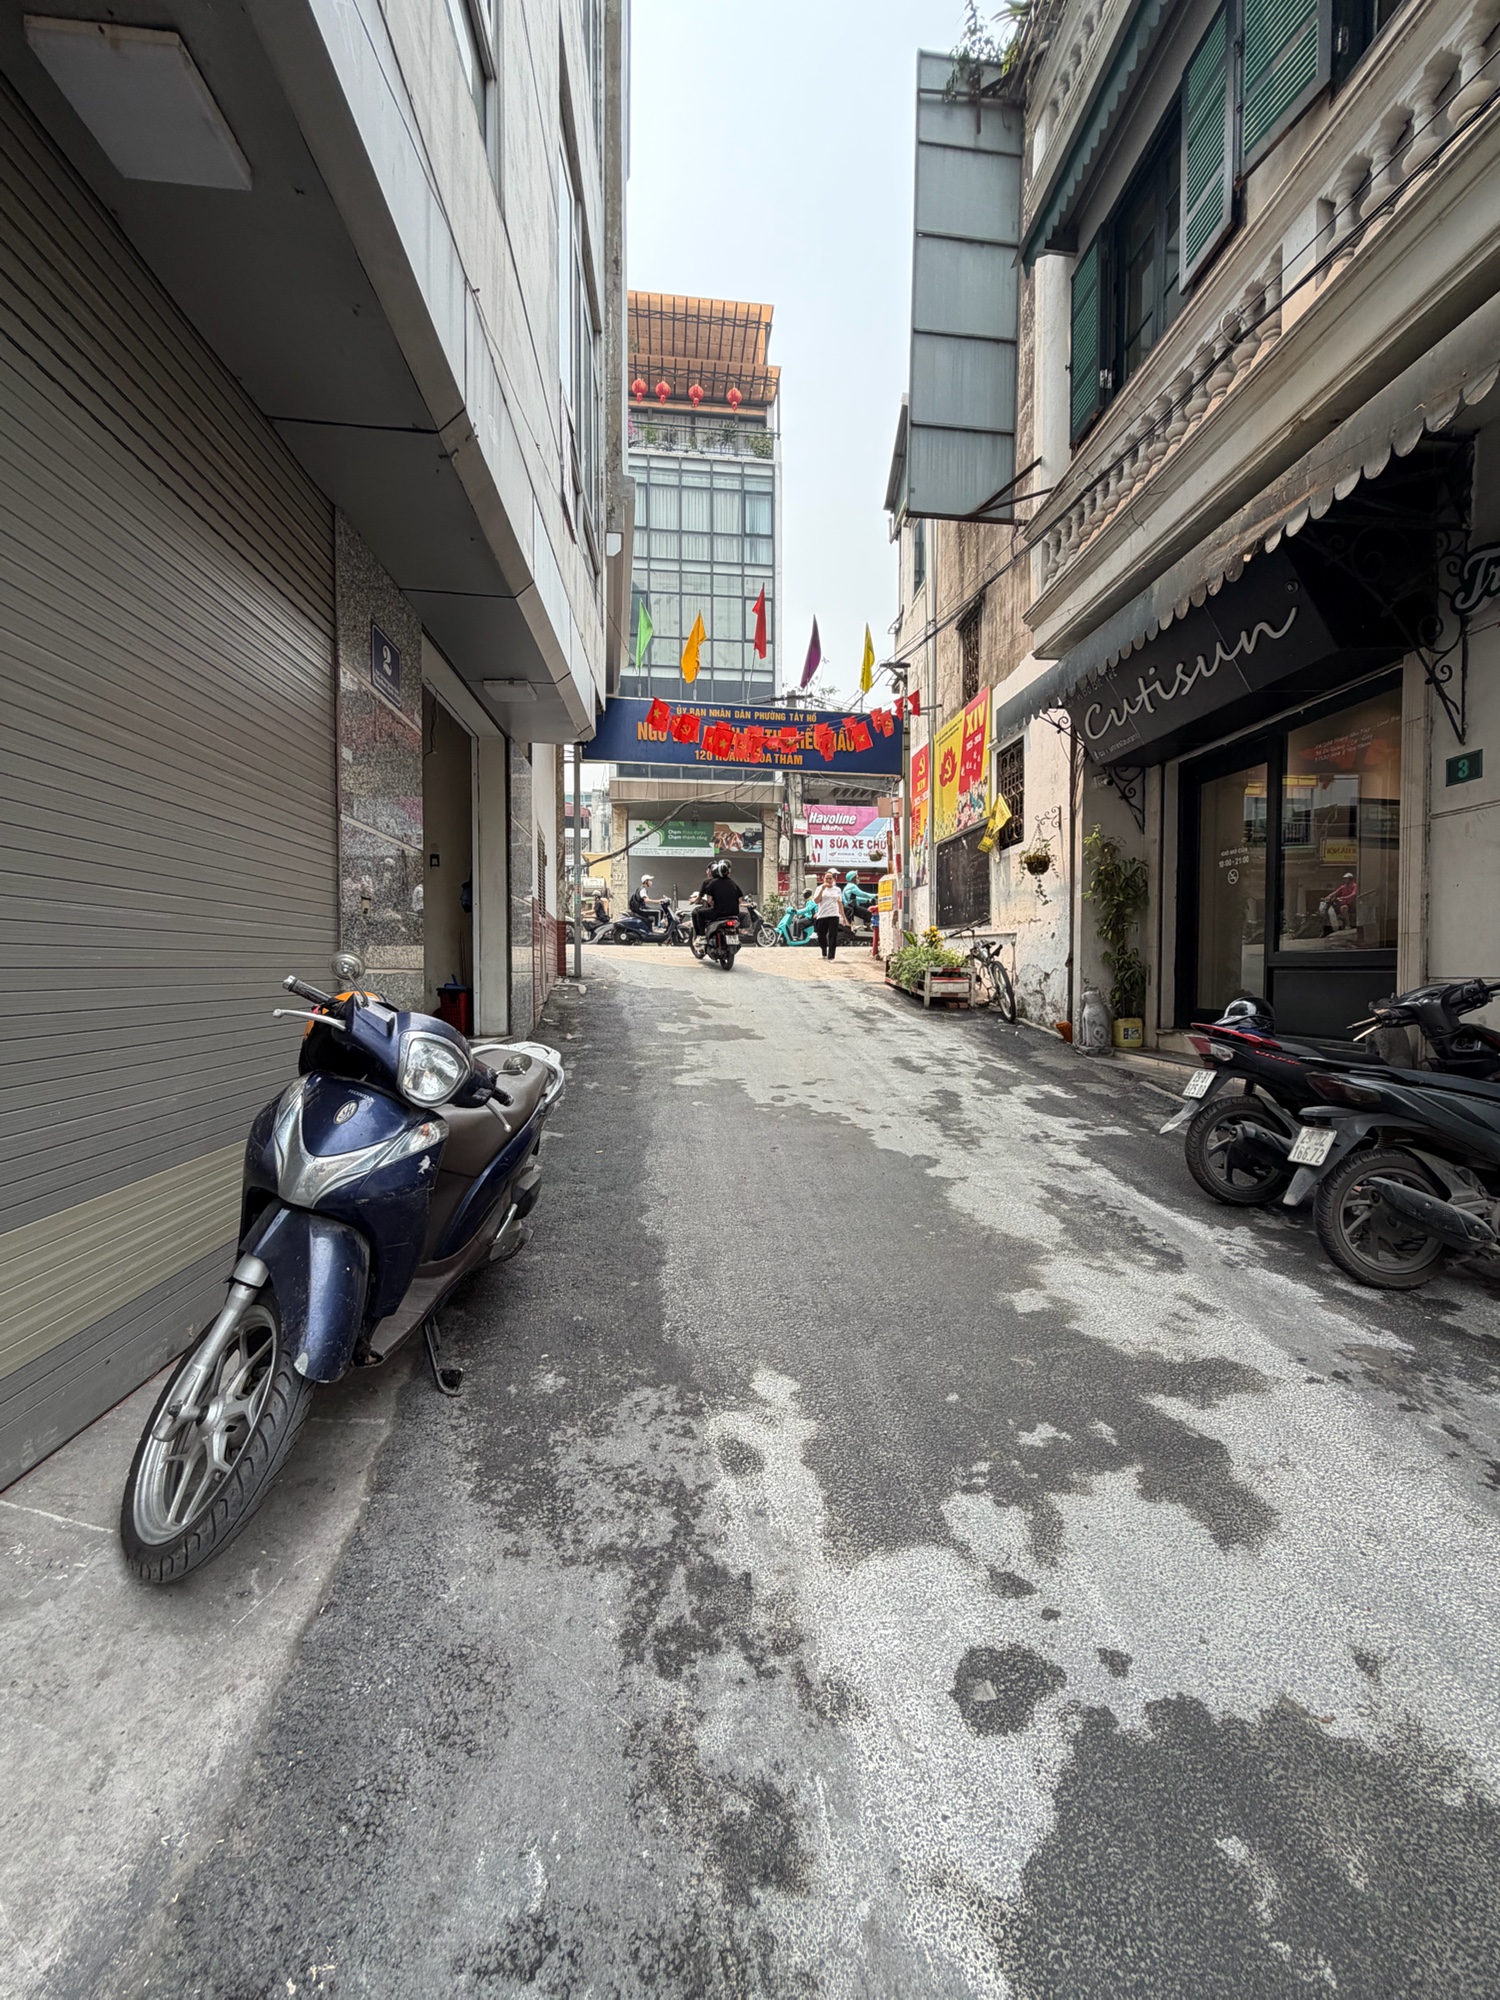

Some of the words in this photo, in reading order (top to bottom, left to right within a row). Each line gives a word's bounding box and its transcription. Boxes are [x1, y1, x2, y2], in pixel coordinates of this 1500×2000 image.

[382, 645, 393, 677] 2
[1084, 606, 1298, 740] Cutisun
[676, 705, 687, 715] ỦY
[709, 708, 731, 718] NHÂN
[734, 708, 751, 719] DÂN
[754, 710, 786, 721] PHƯỜNG
[789, 712, 804, 722] TÂY
[806, 712, 817, 723] HỒ
[965, 700, 986, 738] XIV
[694, 750, 713, 760] 120
[1458, 759, 1469, 778] 3
[809, 812, 857, 825] Havoline
[852, 839, 864, 849] XE
[347, 1088, 375, 1103] HONDA
